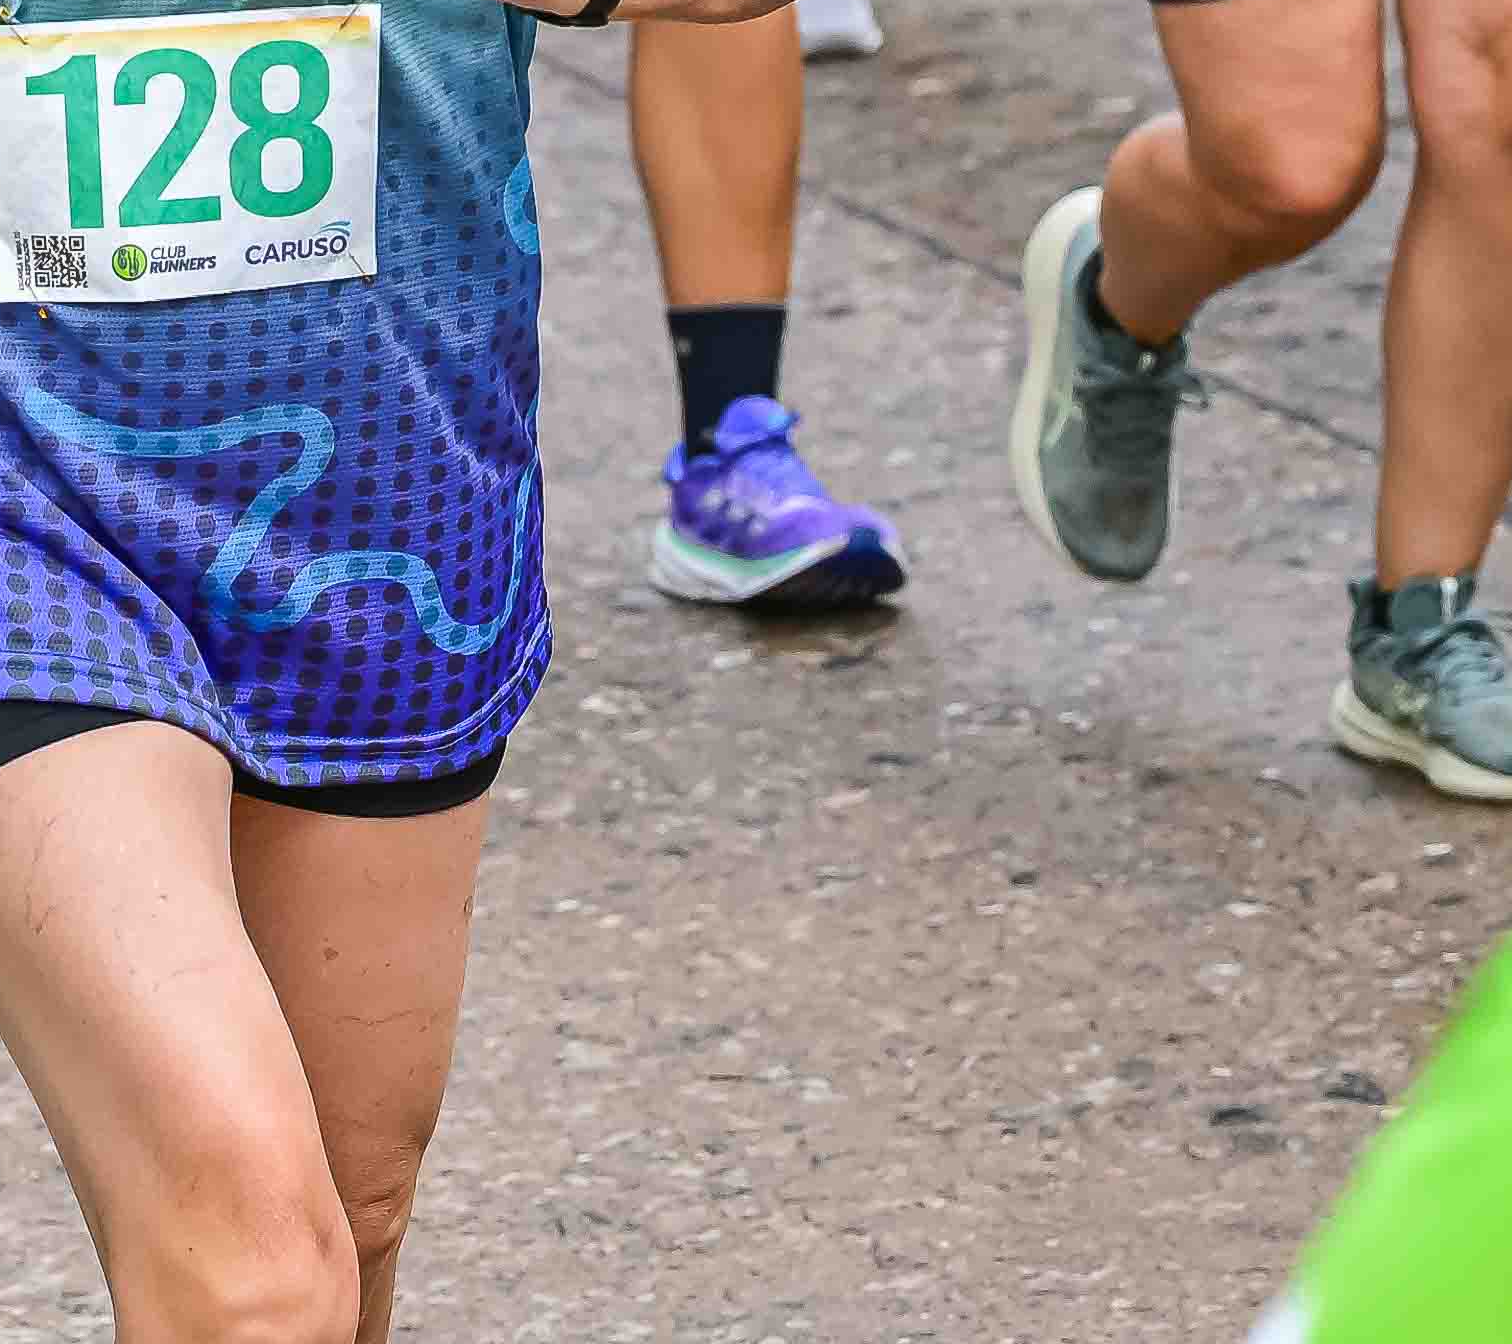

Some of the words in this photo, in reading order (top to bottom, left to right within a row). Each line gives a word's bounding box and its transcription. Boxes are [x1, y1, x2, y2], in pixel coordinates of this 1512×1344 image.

[26, 39, 334, 229] 128
[149, 255, 217, 276] RUNNER'S
[244, 234, 348, 266] CARUSO
[150, 244, 187, 260] CLUB
